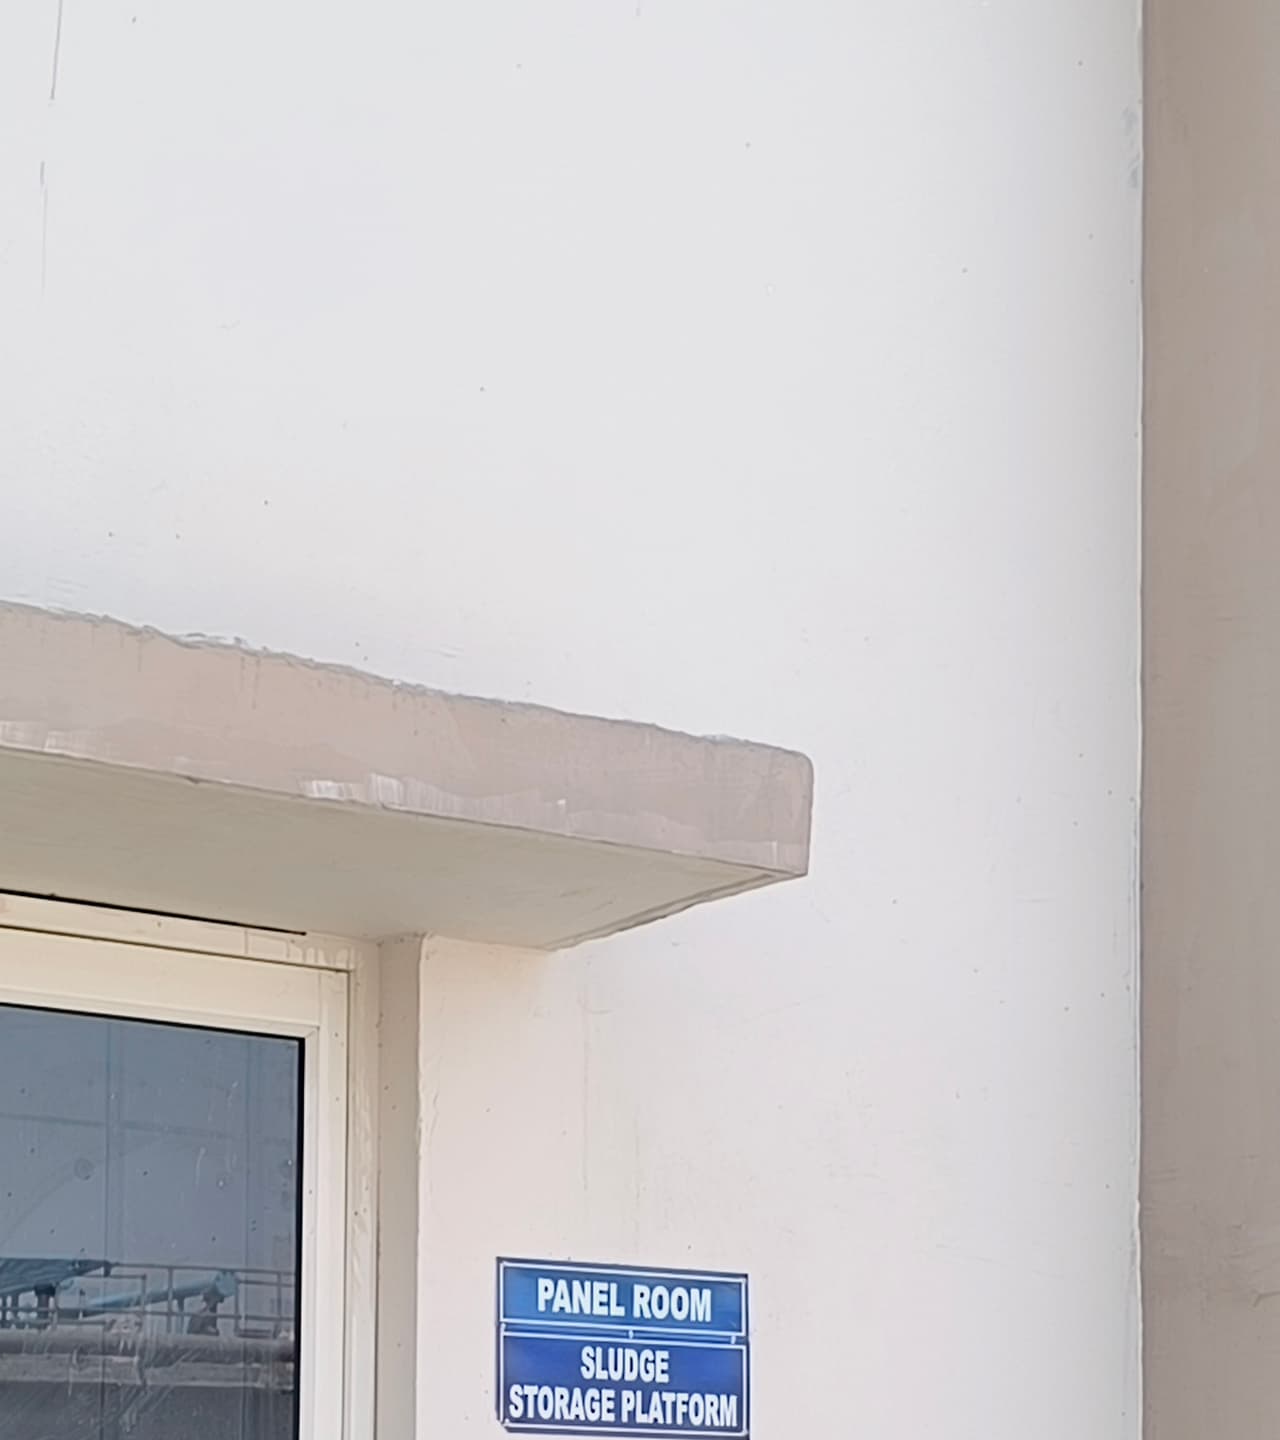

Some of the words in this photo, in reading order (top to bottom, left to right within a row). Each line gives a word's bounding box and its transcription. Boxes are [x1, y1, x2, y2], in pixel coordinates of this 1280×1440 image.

[537, 1277, 625, 1317] PANEL
[633, 1284, 712, 1323] ROOM
[580, 1345, 670, 1384] SLUDGE
[508, 1384, 616, 1423] STORAGE
[621, 1389, 738, 1428] PLATFORM
